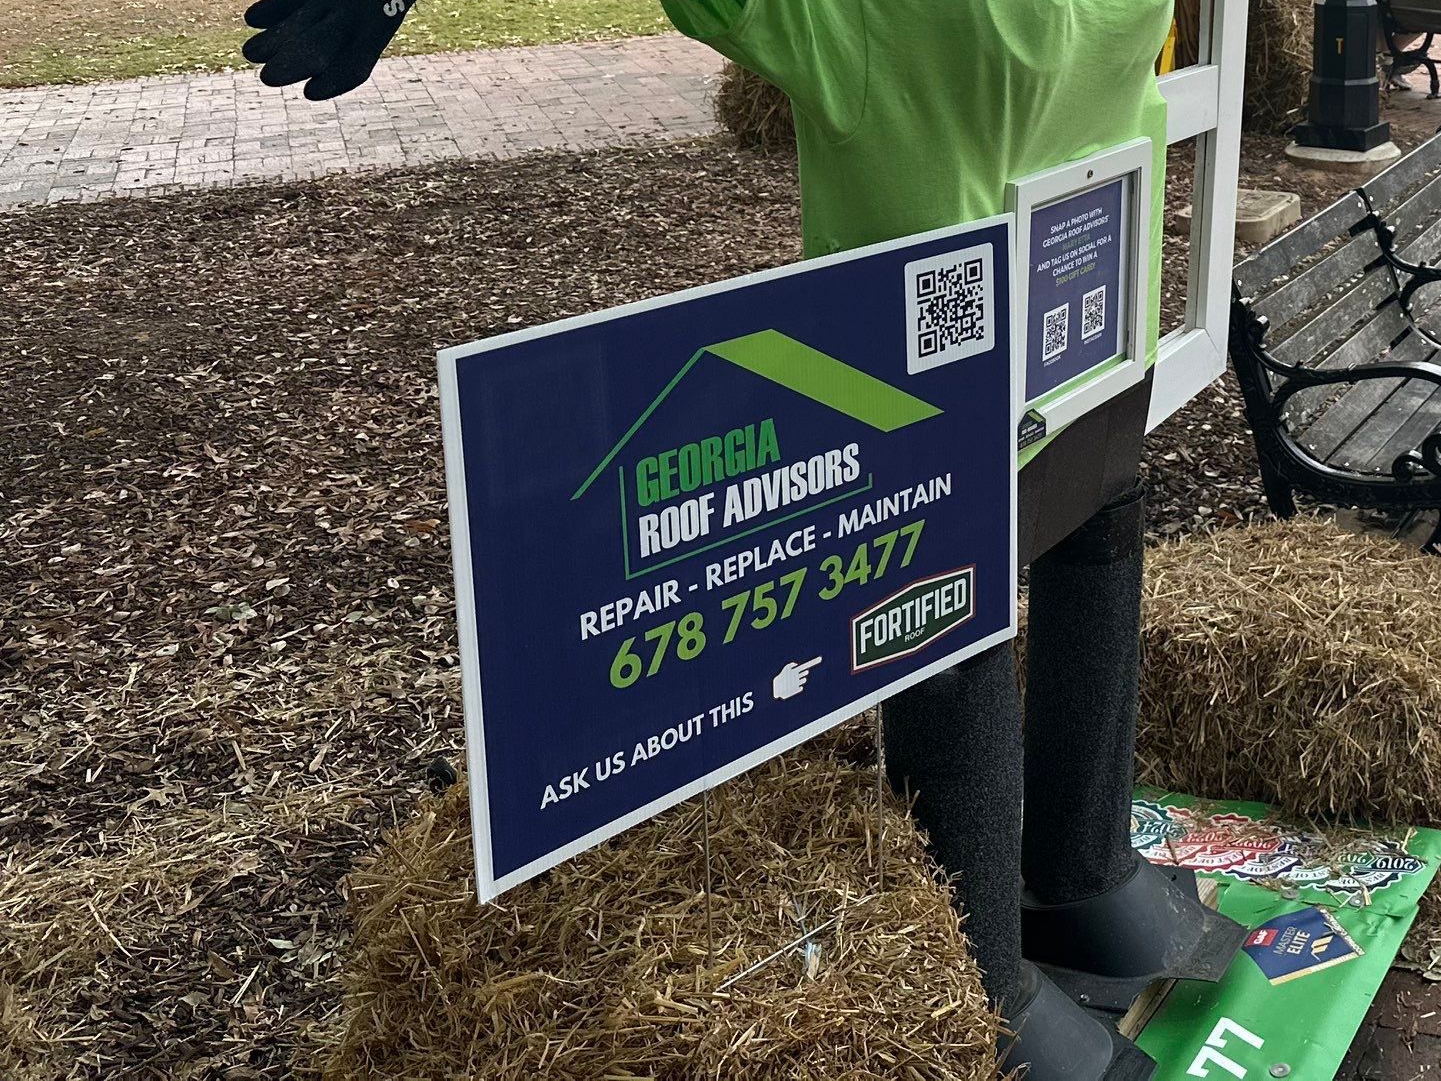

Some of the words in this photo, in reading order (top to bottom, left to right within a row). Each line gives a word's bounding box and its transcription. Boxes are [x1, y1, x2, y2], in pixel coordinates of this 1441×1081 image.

[1042, 231, 1068, 248] GEORGIA
[1068, 225, 1083, 238] ROOF
[1050, 221, 1066, 234] SNAP
[1066, 220, 1071, 228] A
[1071, 213, 1089, 226] PHOTO
[1089, 207, 1103, 219] WITH
[1037, 260, 1051, 273] AND
[1051, 255, 1062, 266] TAG
[1062, 252, 1070, 262] US
[1070, 248, 1079, 259] ON
[1079, 241, 1096, 255] SOCIAL
[1096, 237, 1107, 247] FOR
[1107, 234, 1112, 242] A
[1052, 260, 1075, 277] CHANCE
[1075, 257, 1083, 267] TO
[1093, 250, 1098, 258] A
[635, 417, 782, 509] GEORGIA
[638, 494, 715, 559] ROOF
[722, 442, 860, 531] ADVISORS
[579, 580, 681, 642] REPAIR
[705, 525, 817, 591] REPLACE
[837, 472, 954, 538] MAINTAIN
[609, 612, 707, 690] 678
[720, 567, 806, 644] 757
[818, 518, 926, 600] 3477
[858, 574, 968, 656] FORTIFIED
[904, 626, 926, 643] ROOF
[539, 765, 591, 811] ASK
[594, 750, 626, 782] US
[630, 715, 704, 768] ABOUT
[708, 692, 755, 731] THIS
[1376, 857, 1415, 870] 2019
[1253, 929, 1268, 945] GAF
[1272, 925, 1298, 956] MASTER
[1286, 929, 1311, 955] ELITE
[1186, 1016, 1265, 1080] 77
